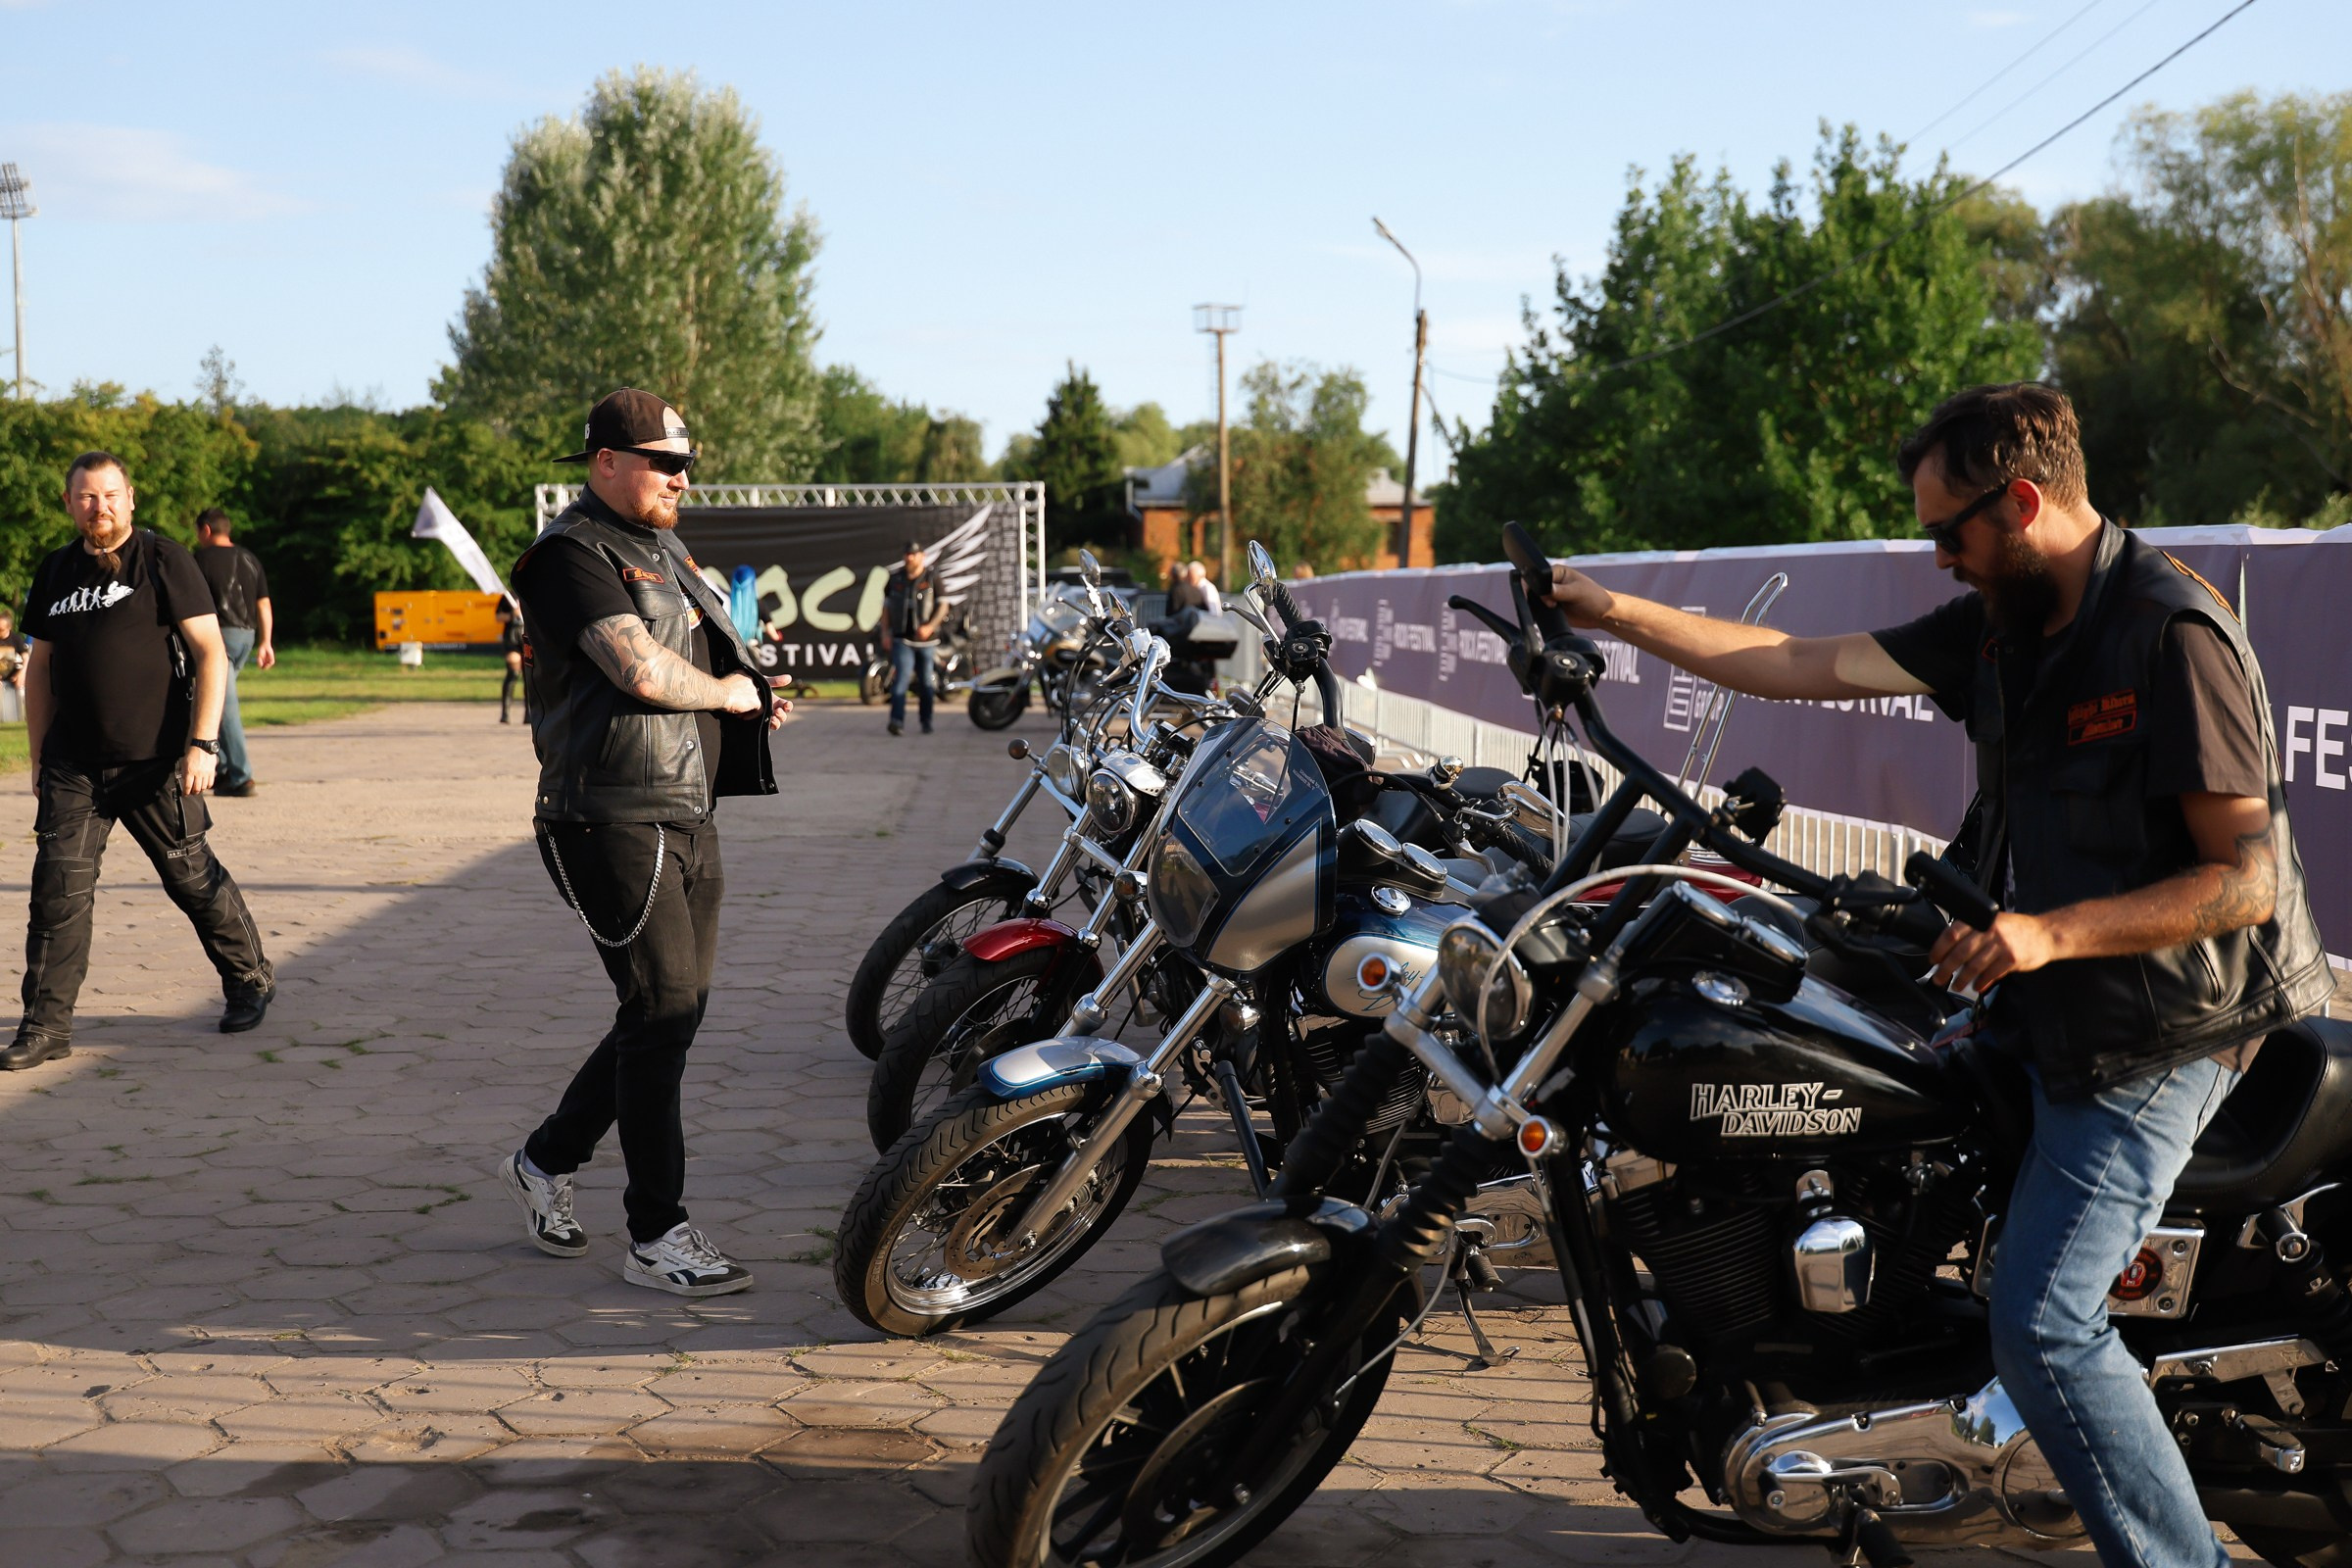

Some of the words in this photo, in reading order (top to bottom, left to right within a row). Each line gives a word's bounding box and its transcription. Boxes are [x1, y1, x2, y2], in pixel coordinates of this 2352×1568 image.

[759, 642, 874, 667] STIVA
[2284, 705, 2352, 791] FE
[1690, 1082, 1843, 1122] HARLEY-
[1720, 1106, 1862, 1137] DAVIDSON
